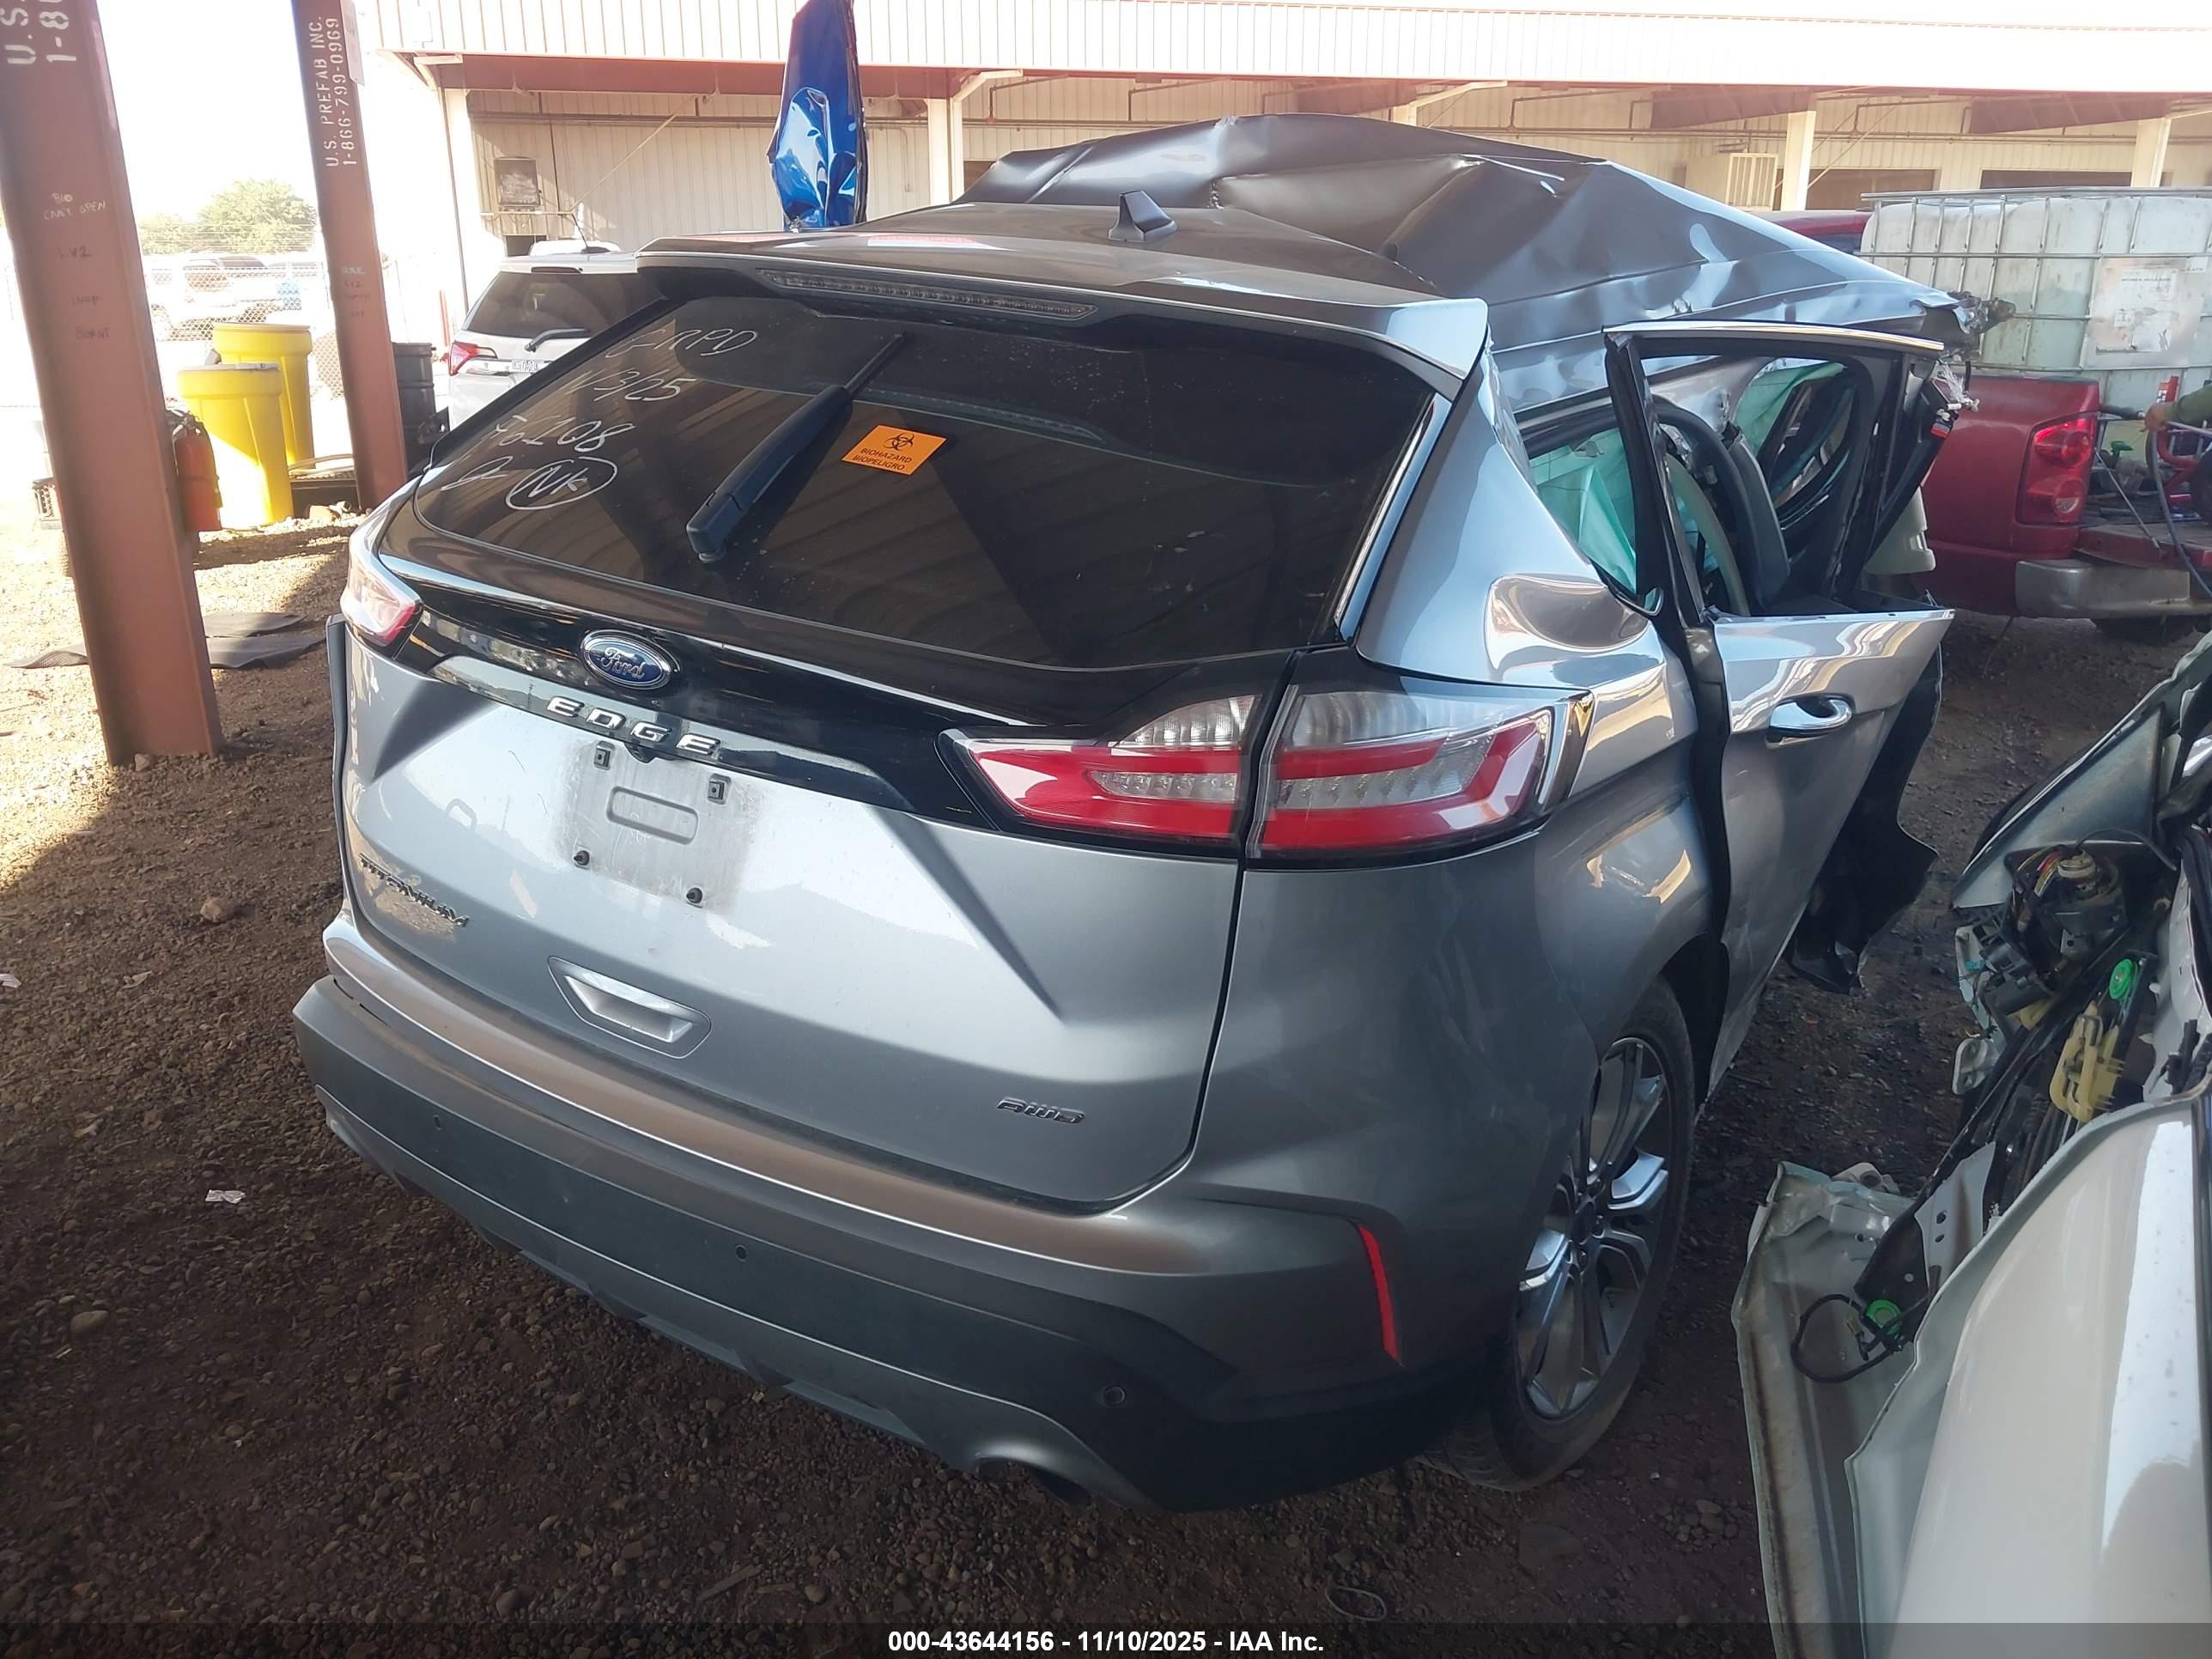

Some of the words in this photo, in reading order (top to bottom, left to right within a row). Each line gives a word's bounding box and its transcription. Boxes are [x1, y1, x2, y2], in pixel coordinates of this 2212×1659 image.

[38, 0, 77, 63] 1-8
[308, 15, 325, 49] INC.
[313, 58, 335, 125] PREFAB
[325, 17, 358, 166] 1-866-799-0969
[324, 135, 340, 167] U.S.
[512, 359, 544, 371] GMC
[852, 454, 906, 471] BIOPELIGRO
[860, 447, 913, 465] BIOHAZARD
[600, 646, 646, 681] Ford
[546, 696, 721, 757] EDGE
[996, 1097, 1085, 1125] AWD
